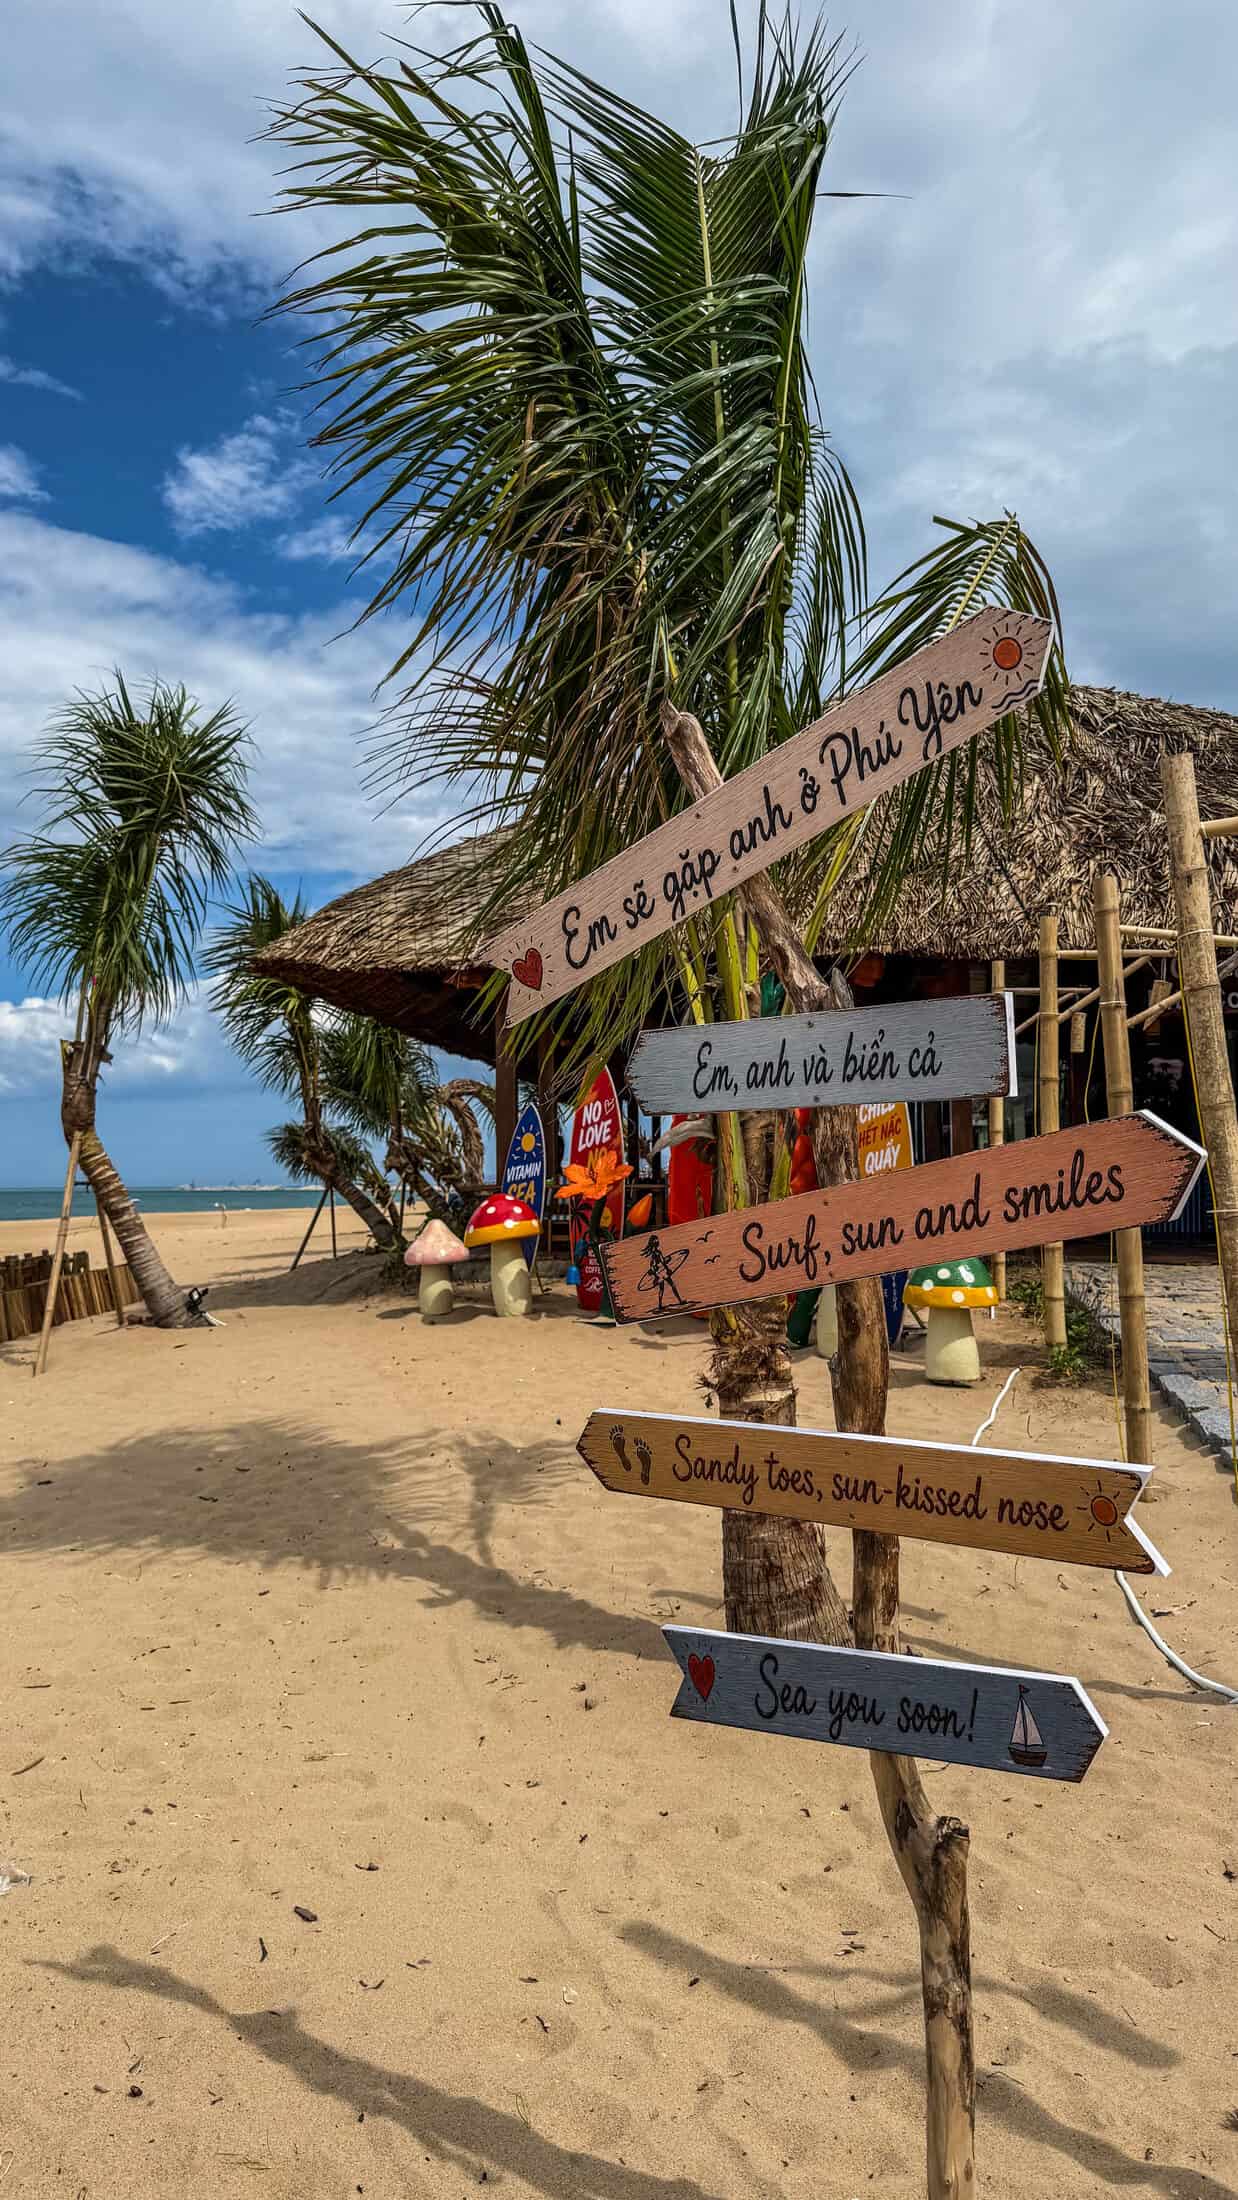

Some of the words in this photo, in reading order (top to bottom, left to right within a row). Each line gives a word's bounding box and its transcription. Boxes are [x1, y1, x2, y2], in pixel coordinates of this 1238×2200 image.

[561, 905, 618, 969] Em
[622, 879, 656, 929] sẽ
[662, 848, 721, 921] gặp
[729, 784, 793, 860] anh
[799, 767, 821, 814] ở
[819, 720, 903, 806] Phú
[897, 680, 983, 761] Yên
[692, 1041, 739, 1099] Em,
[745, 1038, 796, 1090] anh
[802, 1043, 835, 1086] và
[841, 1028, 901, 1083] biển
[907, 1030, 943, 1077] cả
[577, 1119, 612, 1152] LOVE
[582, 1100, 602, 1127] NO
[506, 1161, 542, 1183] VITAMIN
[739, 1214, 831, 1283] Surf,
[841, 1215, 904, 1256] sun
[914, 1172, 990, 1240] and
[1002, 1148, 1125, 1223] smiles
[672, 1433, 760, 1505] Sandy
[764, 1451, 824, 1502] toes,
[831, 1464, 989, 1522] sun-kissed
[997, 1496, 1071, 1533] nose
[754, 1652, 818, 1720] Sea
[827, 1689, 886, 1740] you
[896, 1688, 978, 1742] soon!
